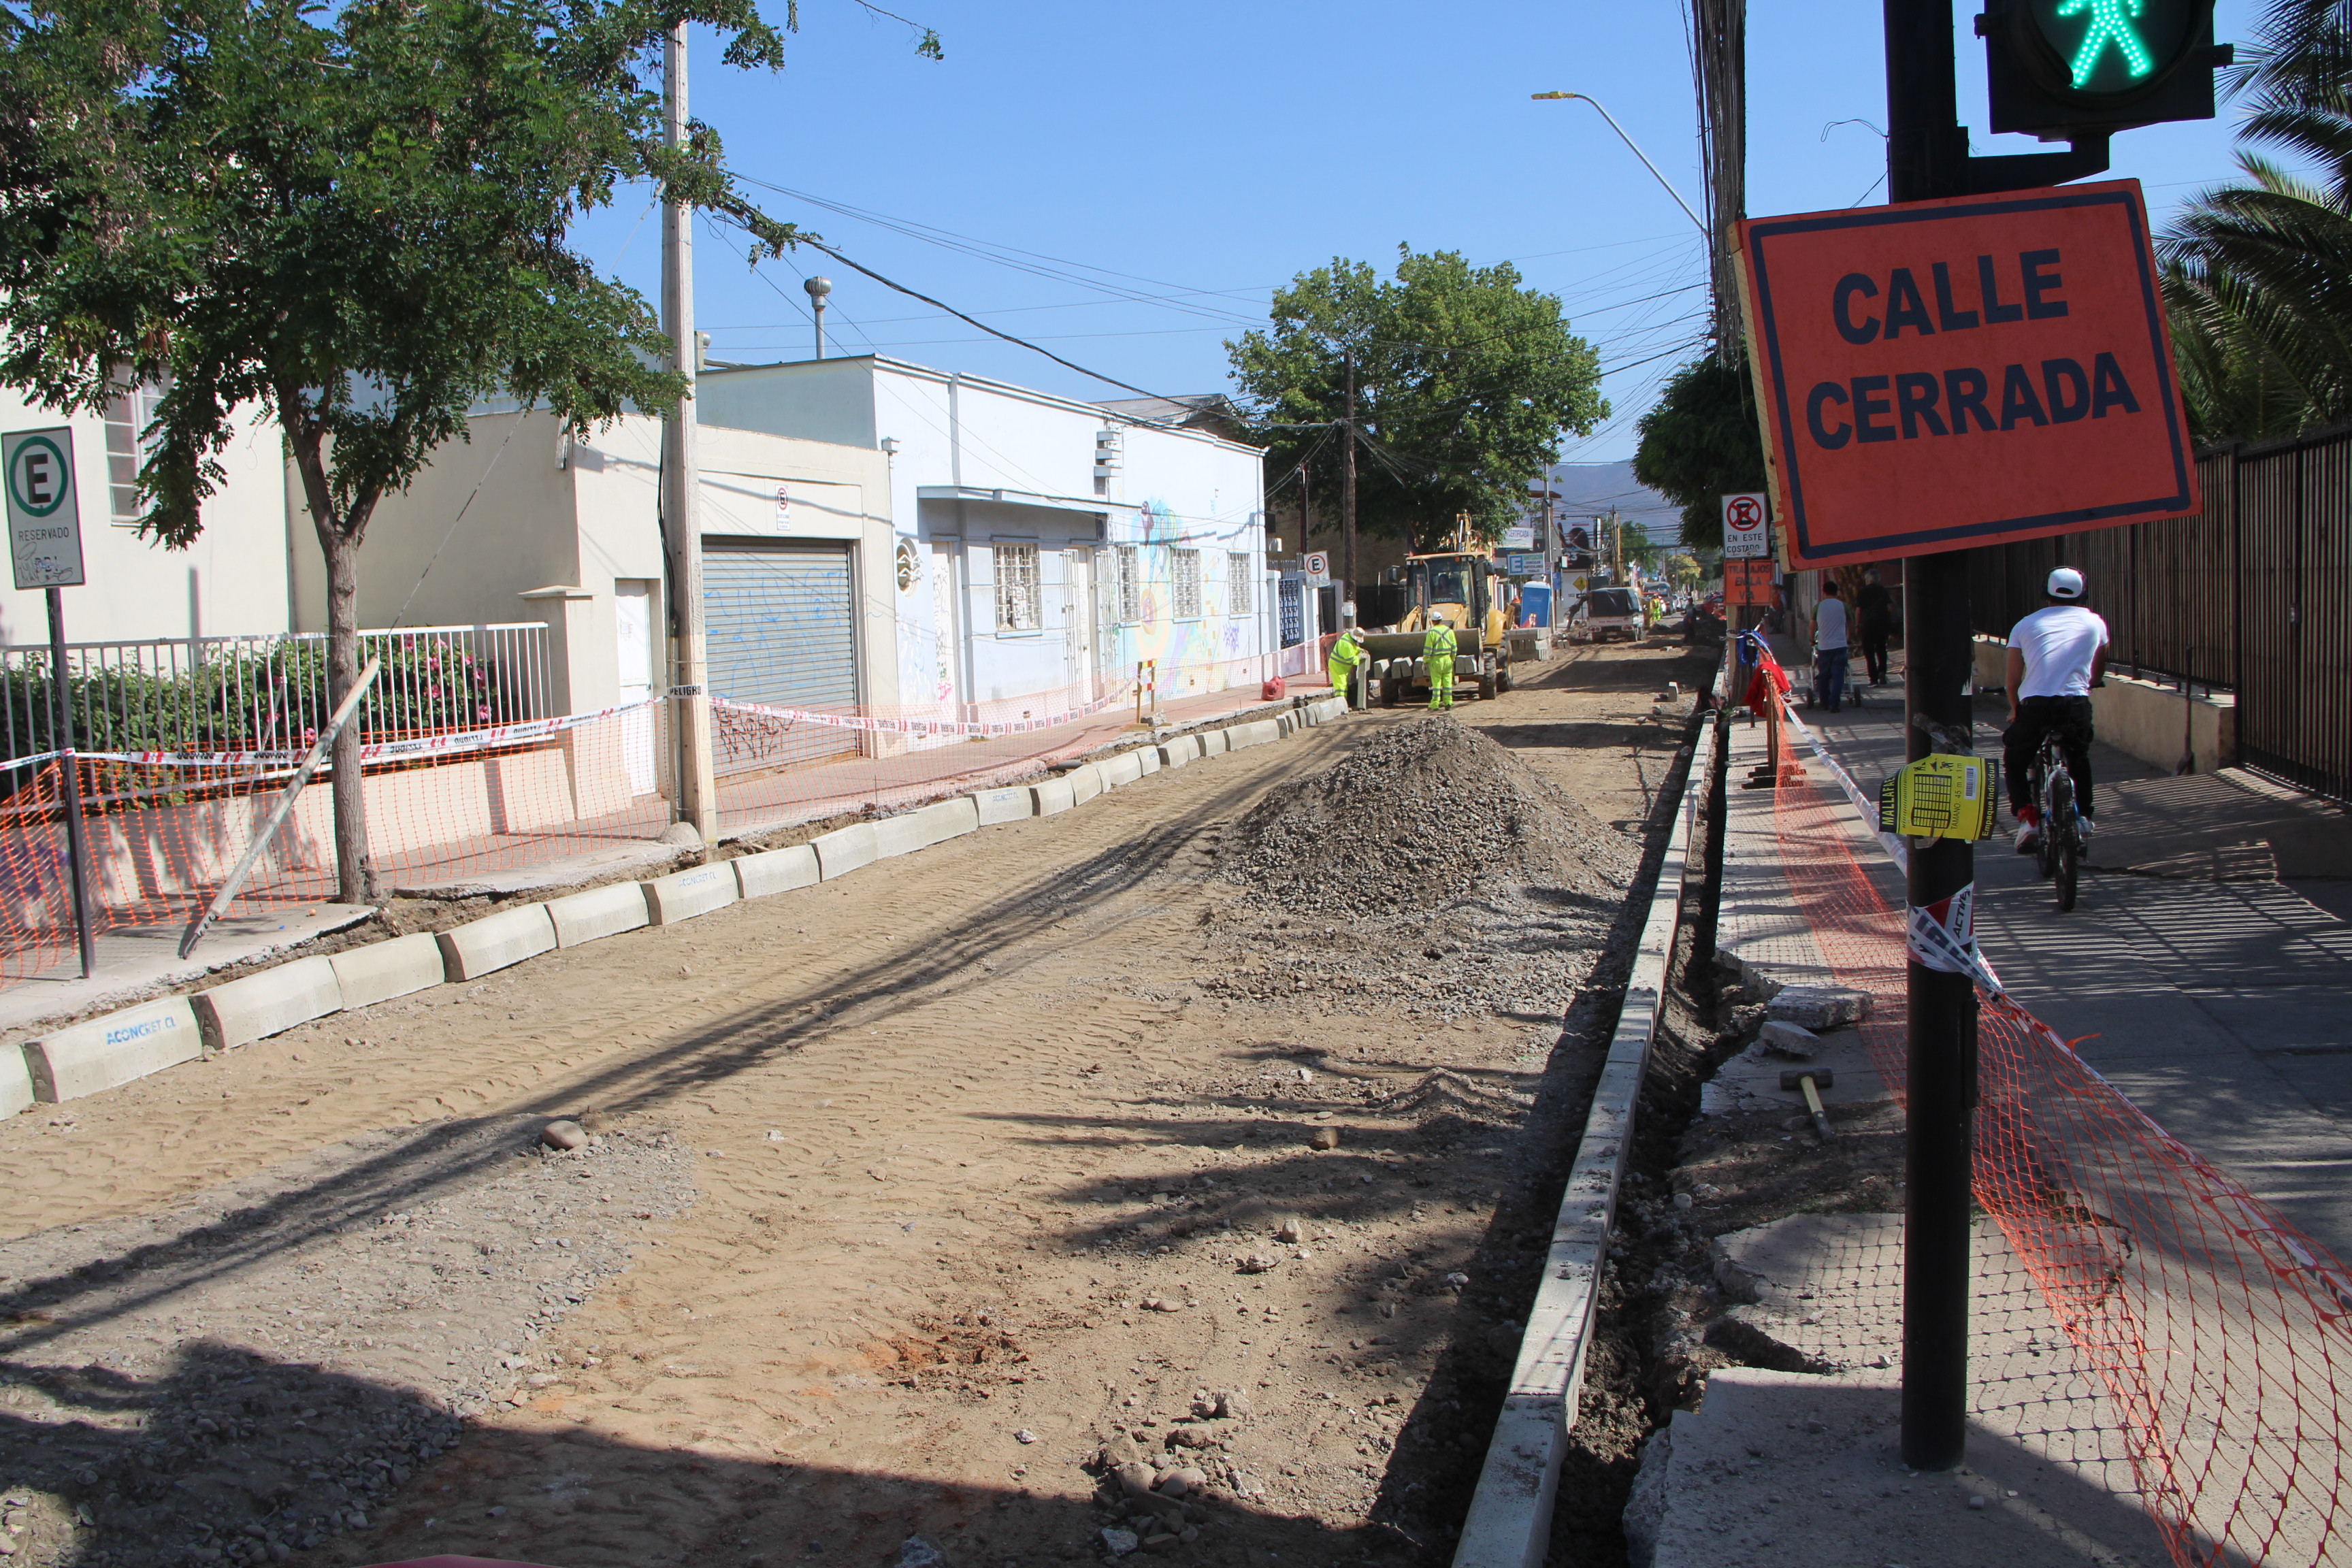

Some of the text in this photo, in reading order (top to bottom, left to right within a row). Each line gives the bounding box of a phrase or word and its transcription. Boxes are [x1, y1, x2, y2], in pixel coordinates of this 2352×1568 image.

[1832, 248, 2069, 345] CALLE
[1806, 351, 2141, 451] CERRADA
[25, 453, 52, 504] E
[18, 527, 69, 542] RESERVADO
[1727, 533, 1763, 542] EN ESTE
[1311, 558, 1320, 571] E
[1728, 565, 1770, 574] TRAAJOS
[1740, 591, 1754, 600] VA
[670, 685, 701, 696] PELIGRO
[1955, 790, 1961, 798] 45
[1982, 762, 1995, 836] Empaque Individual
